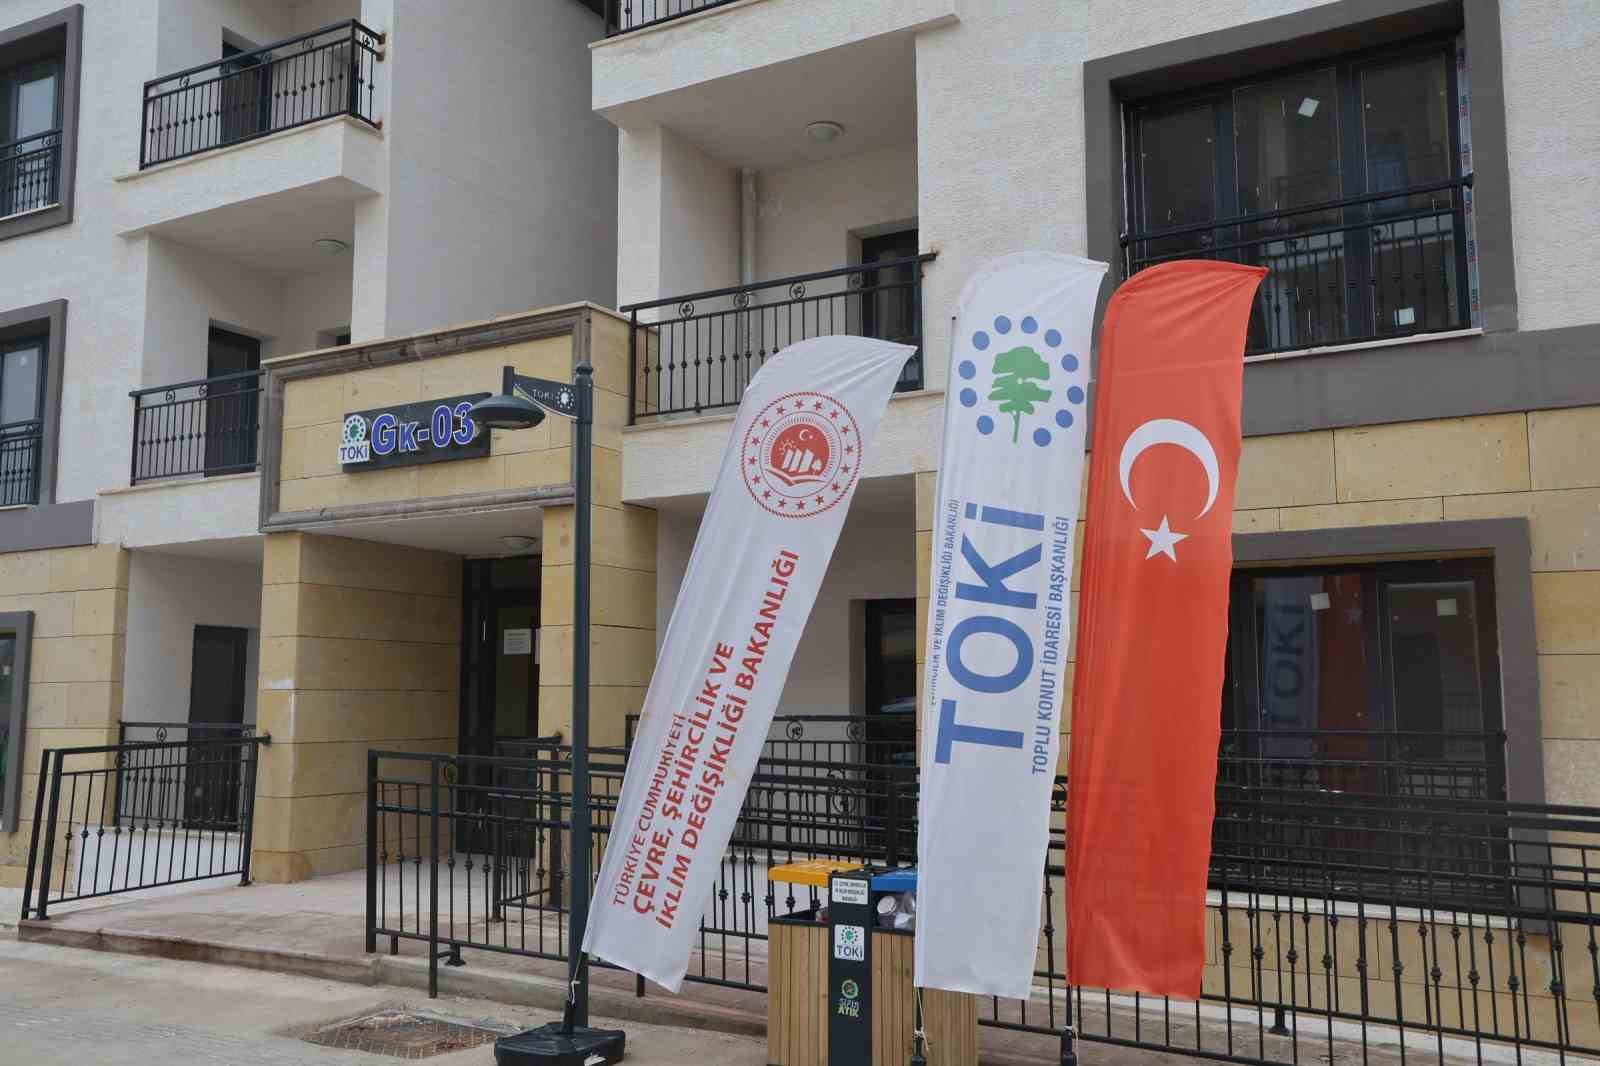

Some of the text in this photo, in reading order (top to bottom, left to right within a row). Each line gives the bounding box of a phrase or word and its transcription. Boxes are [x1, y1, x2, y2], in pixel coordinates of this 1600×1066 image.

[656, 549, 800, 929] İKLİM DEĞİŞİKLİĞİ BAKANLIĞI
[934, 502, 1046, 764] TOKİ
[1032, 517, 1070, 774] TOPLU KONUT İDARESİ BAŞKANLIĞI
[613, 713, 685, 907] TÜRKİYE CUMHURİYETİ
[633, 641, 734, 915] ÇEVRE, ŞEHİRCİLİK VE
